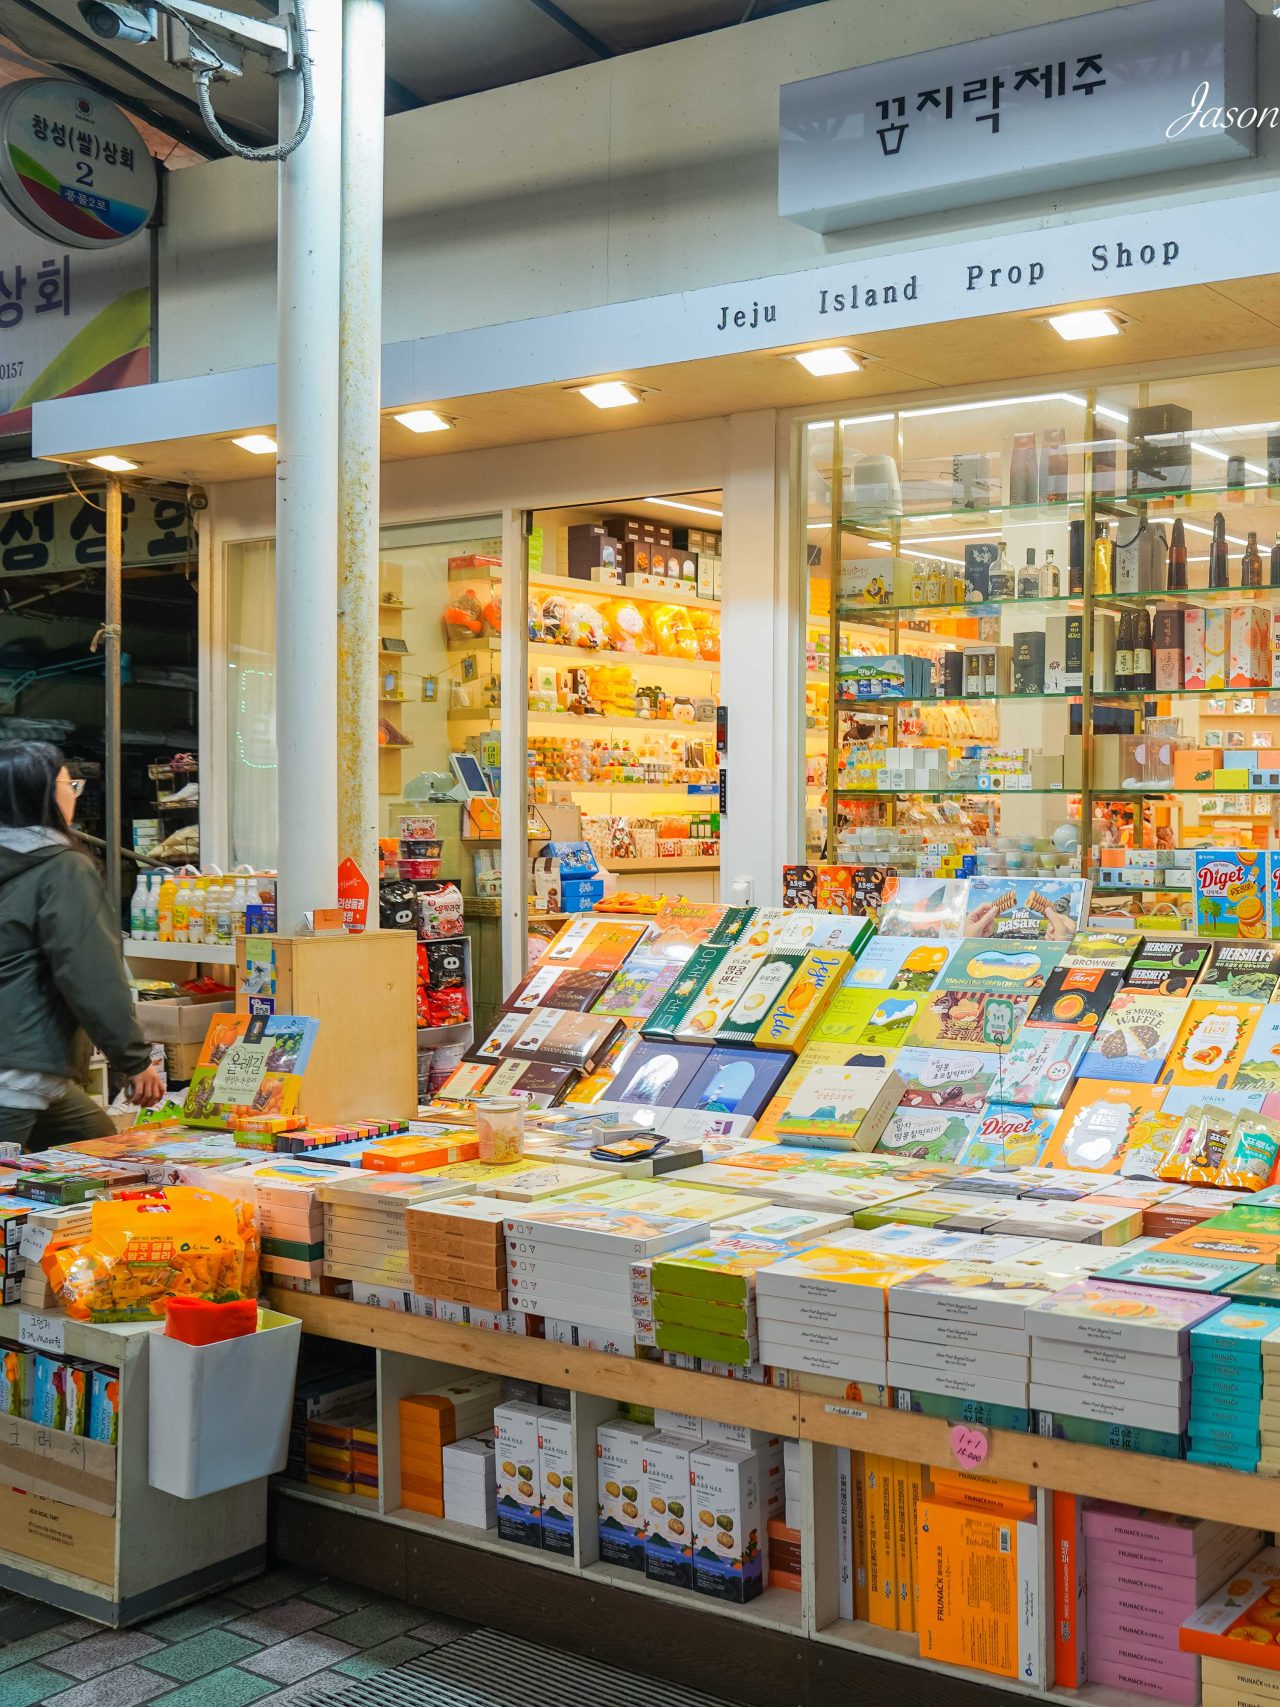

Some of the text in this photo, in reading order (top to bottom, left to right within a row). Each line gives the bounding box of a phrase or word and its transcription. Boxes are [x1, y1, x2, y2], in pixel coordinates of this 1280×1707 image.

[32, 113, 134, 172] 창성(쌀)상회
[75, 161, 94, 187] 2
[717, 239, 1181, 331] Jeju Island Prop Shop
[1199, 866, 1245, 889] Diget
[1088, 932, 1118, 944] Market
[1144, 942, 1183, 953] HERSHEY'S
[1218, 947, 1275, 963] HERSHEY'S
[1071, 958, 1117, 968] BROWNIE
[807, 956, 840, 990] Jeju
[1130, 969, 1170, 980] HERSHEY'S
[1126, 1007, 1164, 1018] S'MORES
[1116, 1015, 1165, 1029] WAFFLE
[1050, 1065, 1066, 1075] 2+1
[982, 1112, 1033, 1136] Diget
[631, 1265, 648, 1278] Diget
[633, 1292, 648, 1306] Diget
[636, 1319, 653, 1332] Diget
